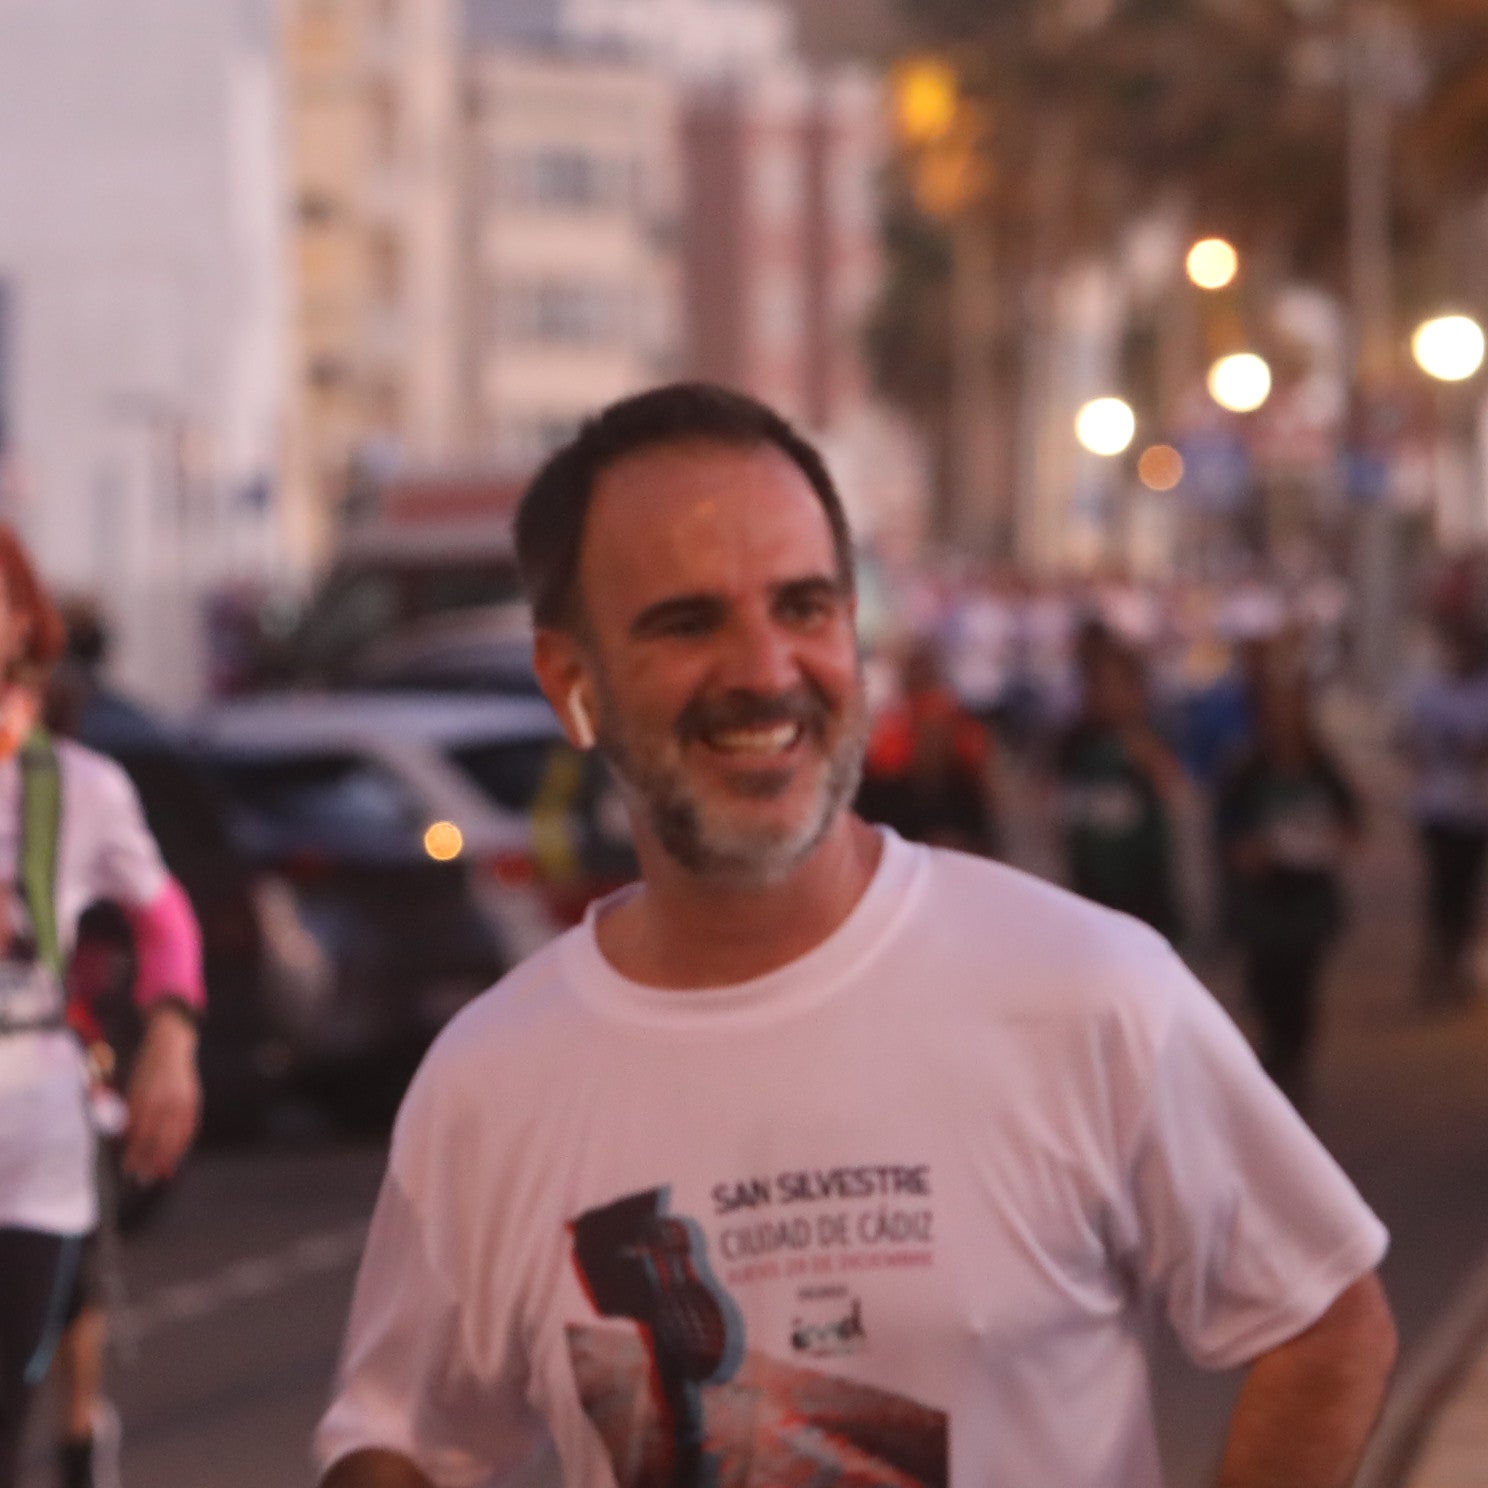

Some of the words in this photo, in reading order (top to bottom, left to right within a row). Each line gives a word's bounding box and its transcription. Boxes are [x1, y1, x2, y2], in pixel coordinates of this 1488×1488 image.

[713, 1176, 770, 1215] SAN
[776, 1164, 931, 1203] SILVESTRE
[719, 1216, 810, 1261] CIUDAD
[816, 1213, 850, 1249] DE
[857, 1203, 933, 1246] CÁDIZ
